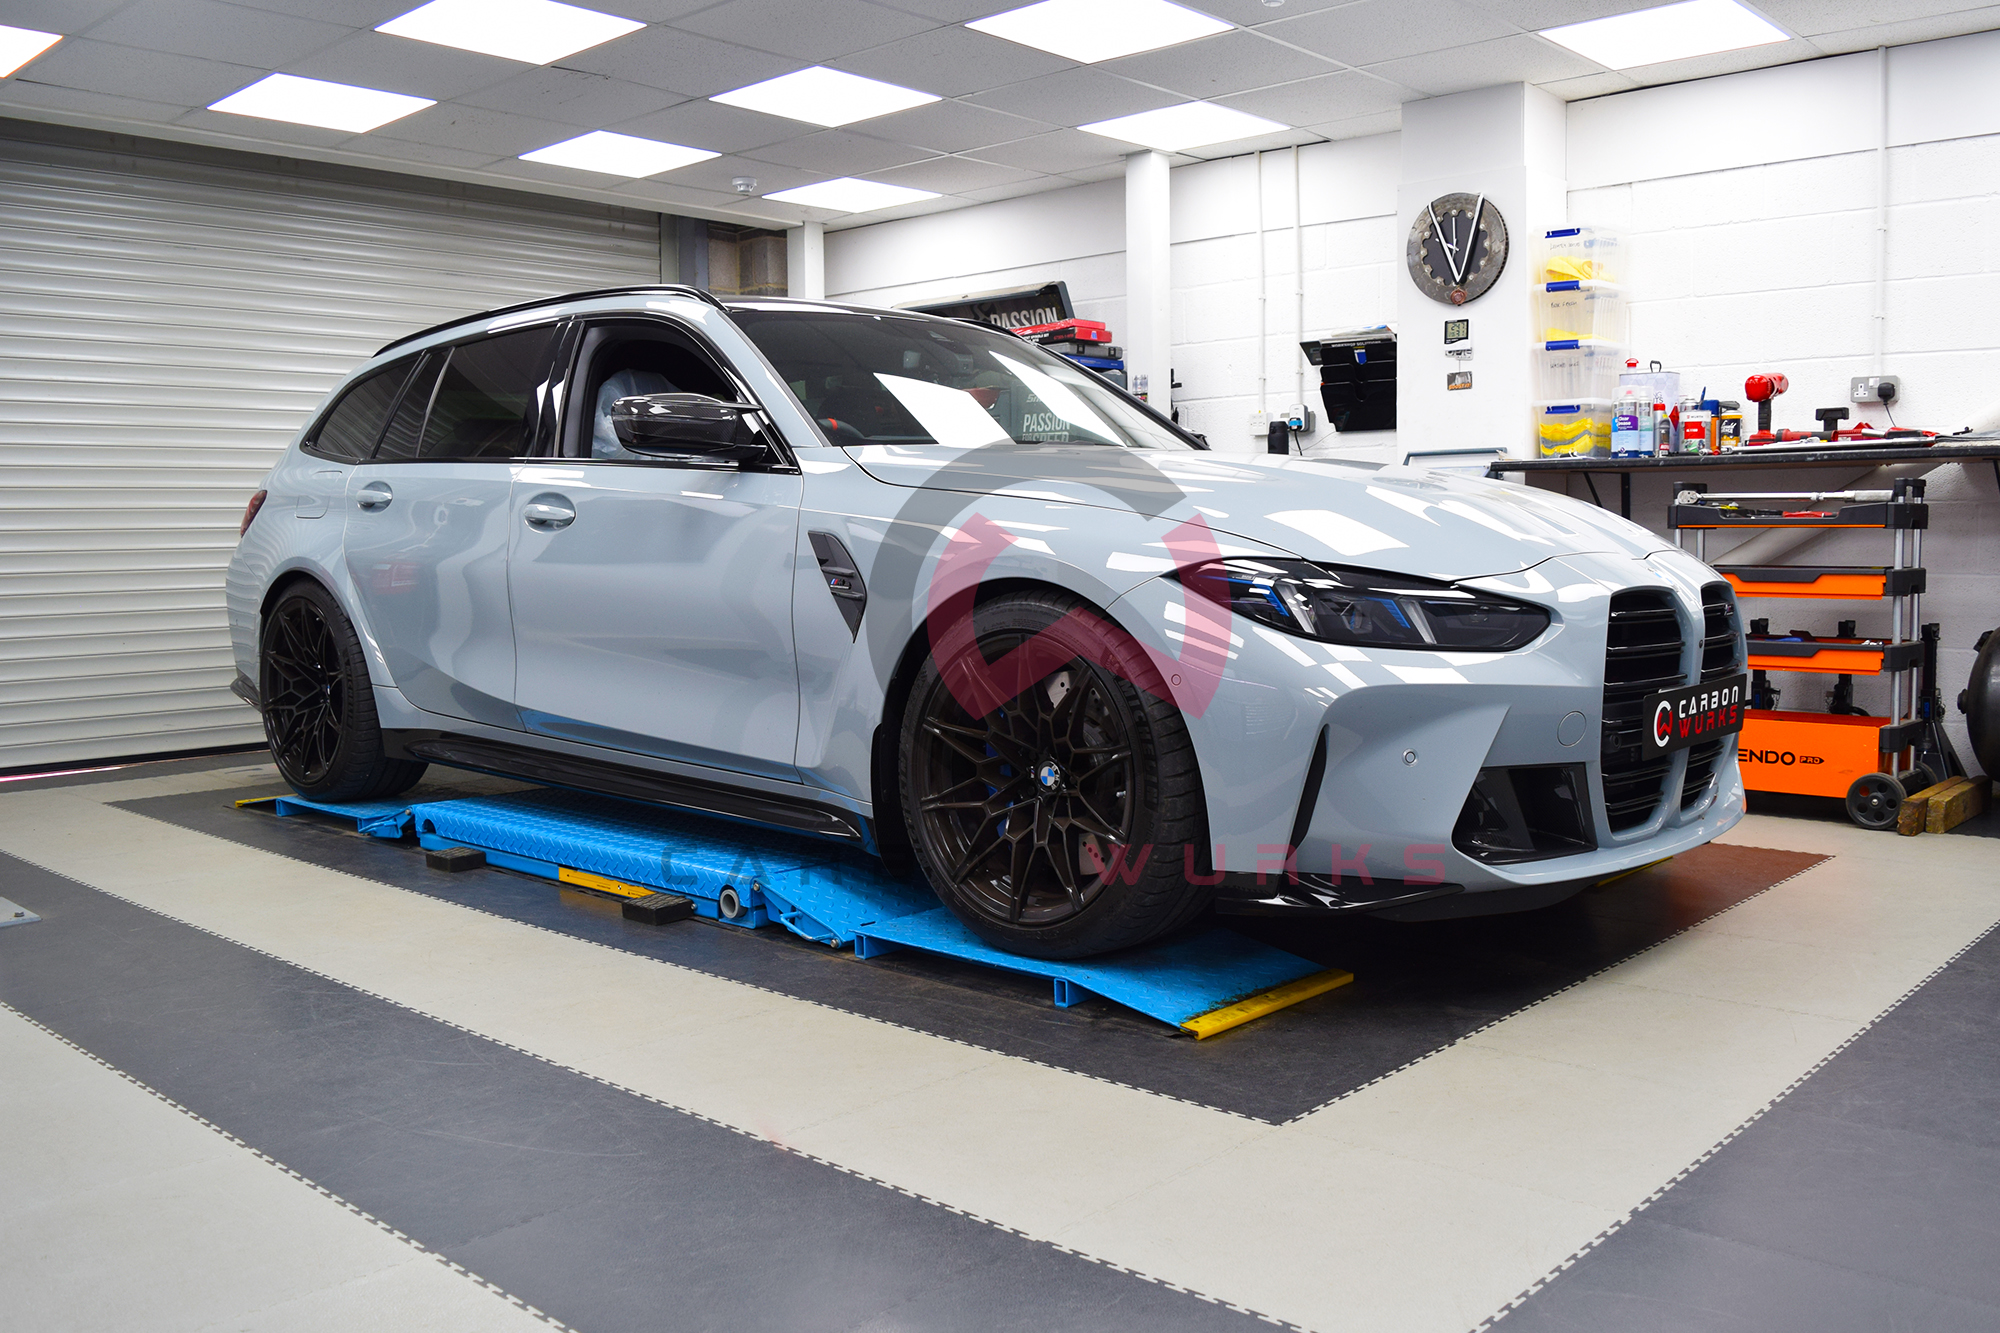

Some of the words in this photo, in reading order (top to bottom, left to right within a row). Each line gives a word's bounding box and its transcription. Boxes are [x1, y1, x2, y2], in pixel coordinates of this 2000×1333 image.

[1679, 685, 1739, 719] CARBON
[1679, 704, 1739, 739] WURKS
[1118, 674, 1159, 806] MICHELIN
[1800, 756, 1821, 764] PRO
